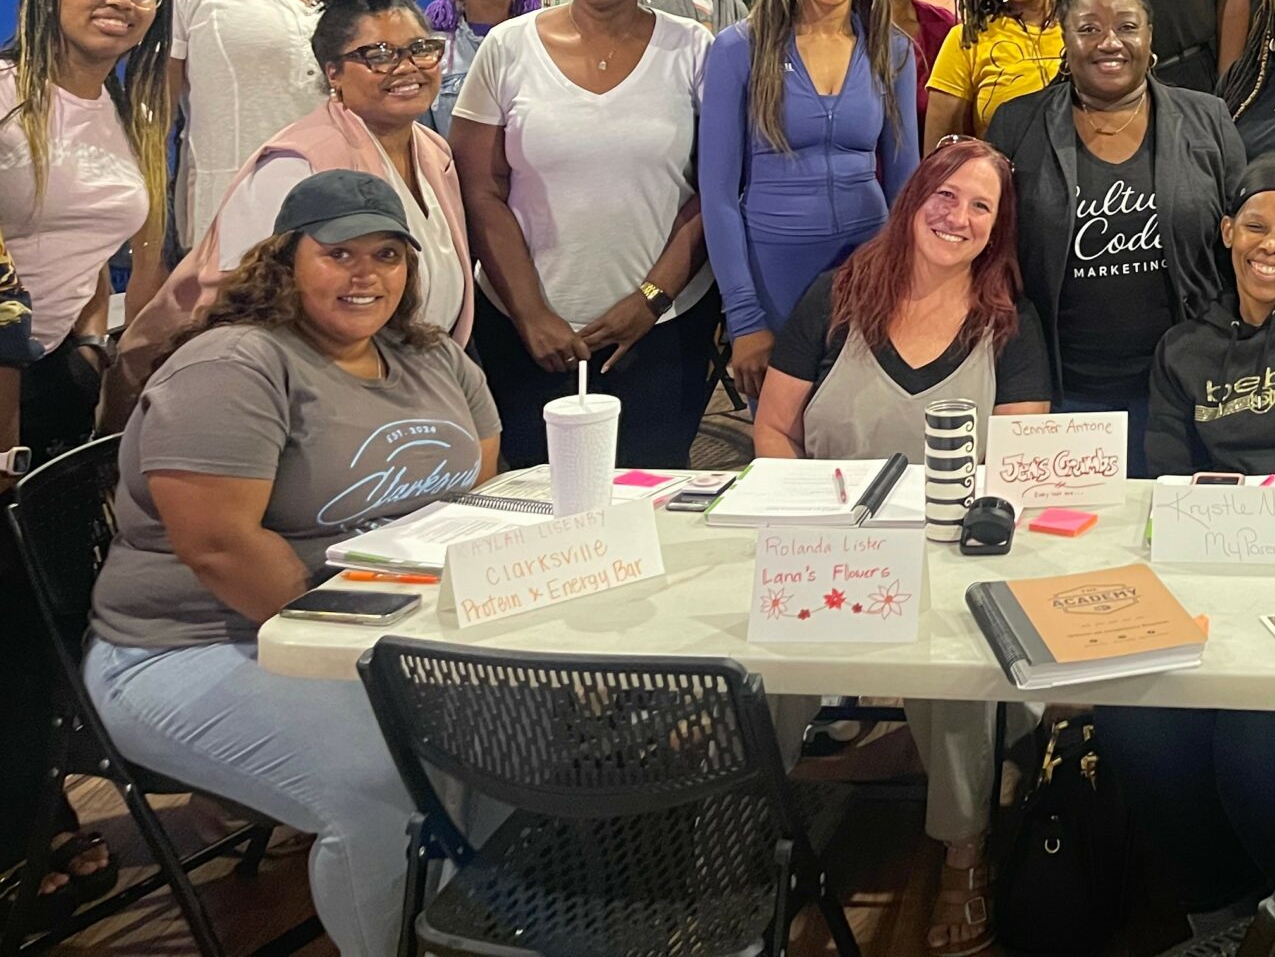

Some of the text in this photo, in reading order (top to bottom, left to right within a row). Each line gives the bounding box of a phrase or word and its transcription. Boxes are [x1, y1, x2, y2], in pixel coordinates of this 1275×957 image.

[1076, 180, 1157, 218] ultu
[1012, 418, 1113, 436] Jennifer Antone
[538, 509, 606, 538] LISENBY
[1156, 489, 1254, 530] Krystle
[765, 535, 887, 556] Rolanda Lister
[1205, 531, 1242, 562] My
[486, 539, 608, 586] Clarksville
[832, 563, 891, 582] Flowers
[461, 592, 522, 623] Protein
[547, 569, 610, 601] Energy
[612, 558, 643, 582] Bar
[1052, 587, 1137, 608] ACADEMY
